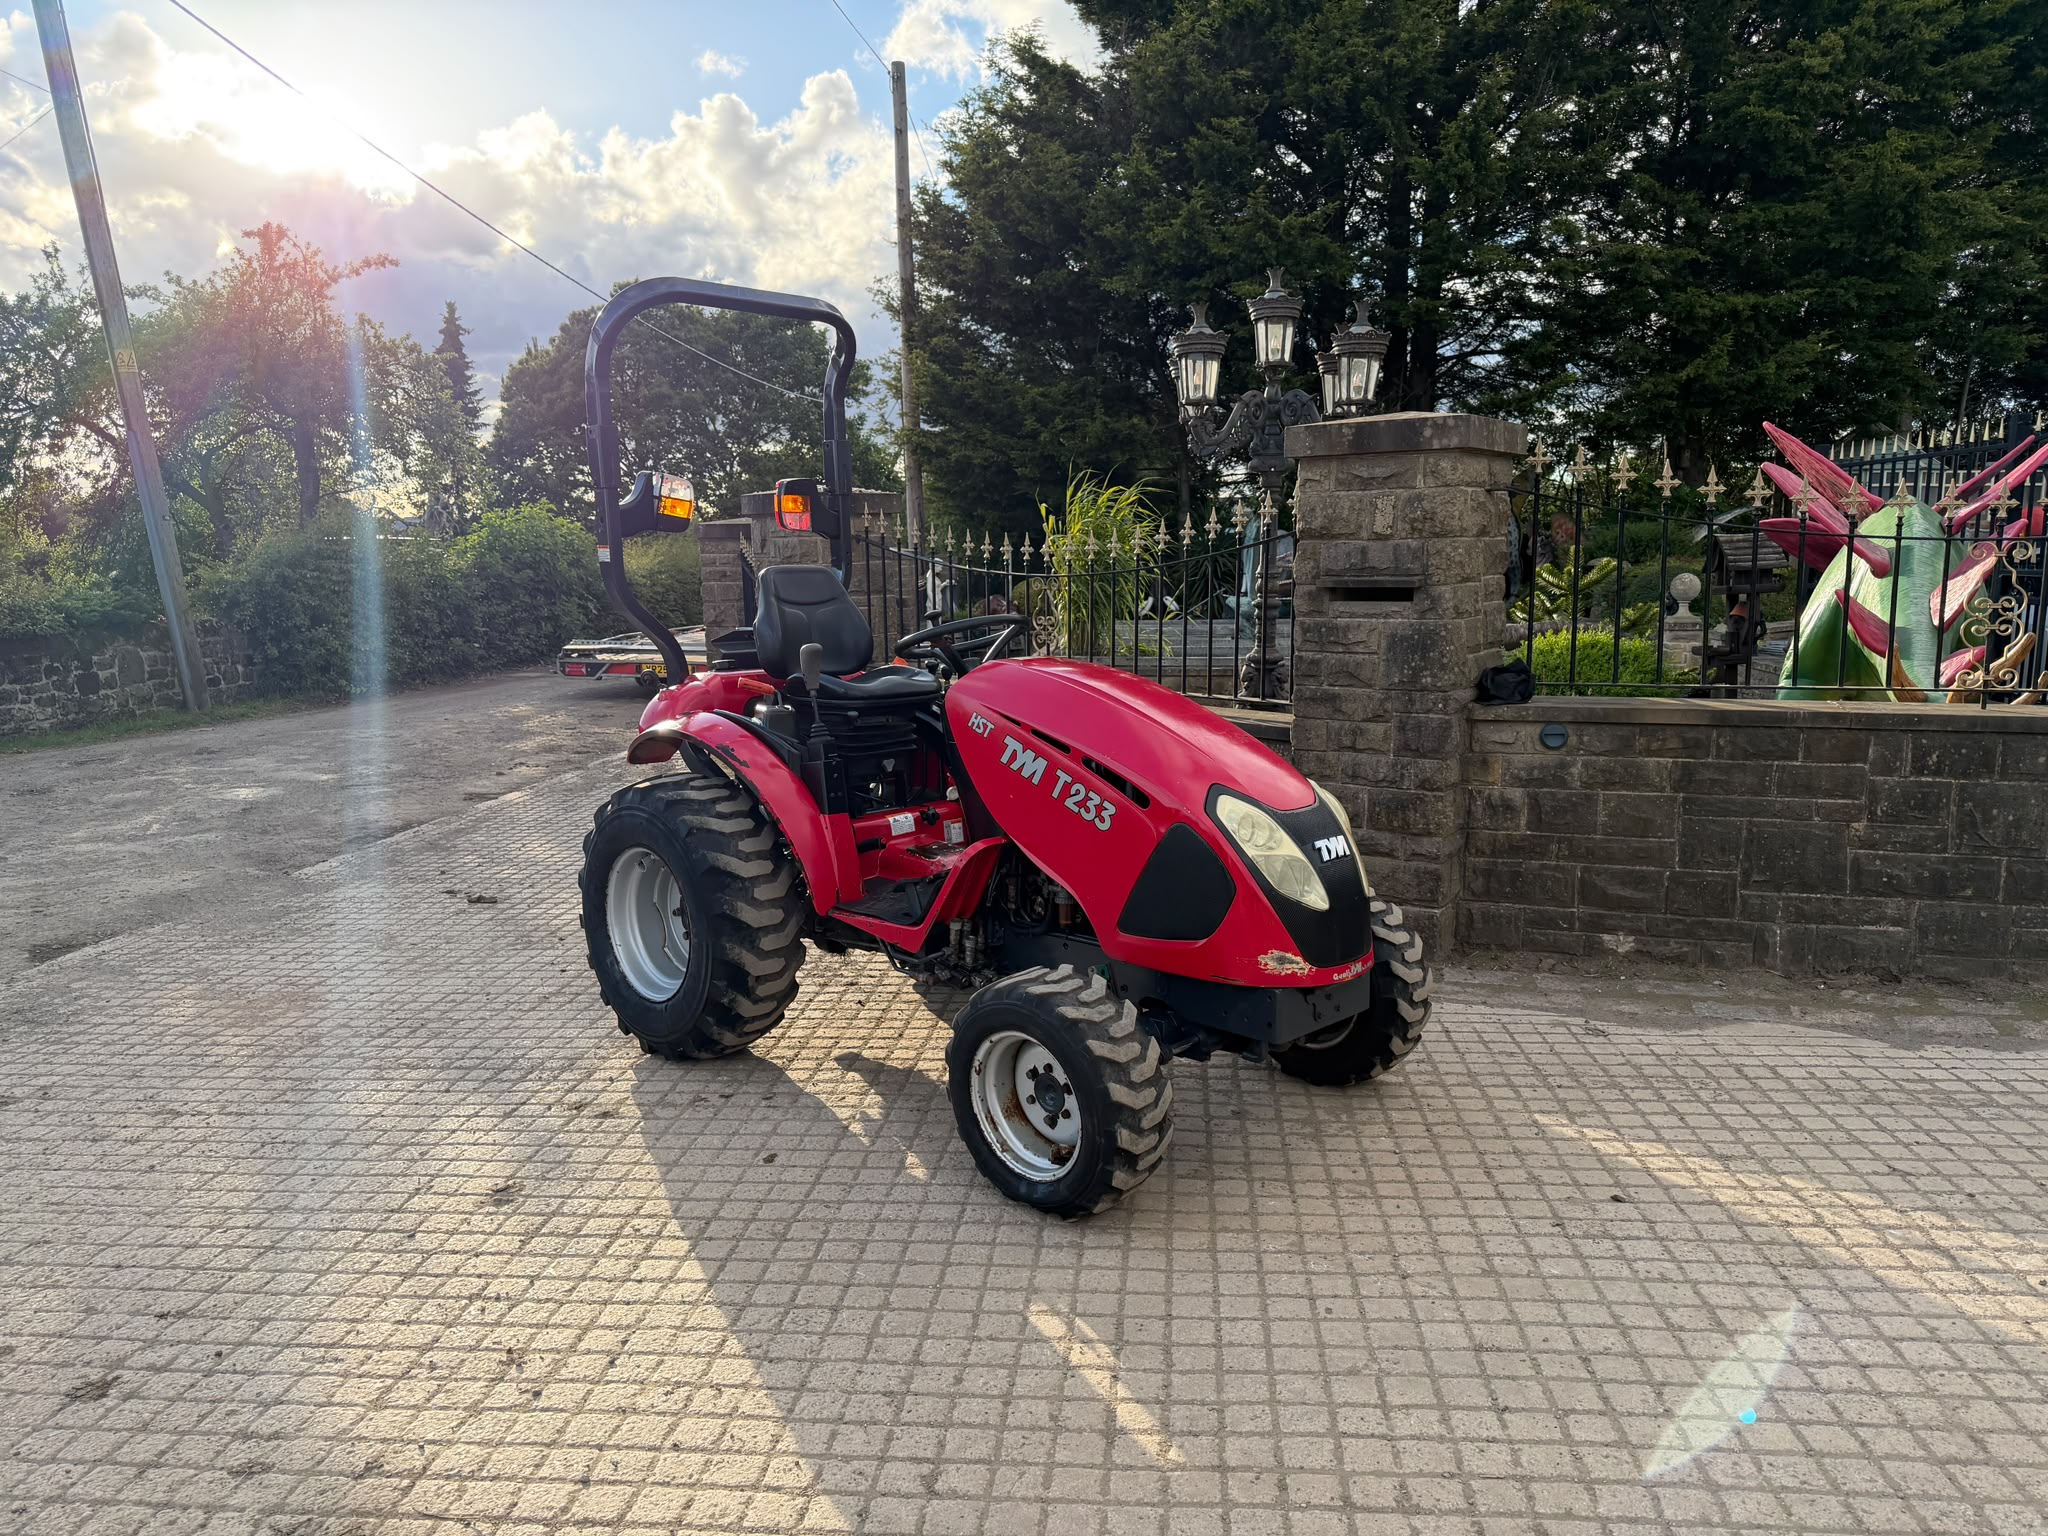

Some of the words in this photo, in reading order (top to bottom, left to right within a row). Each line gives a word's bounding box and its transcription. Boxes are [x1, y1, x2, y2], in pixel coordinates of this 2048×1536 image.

[967, 712, 995, 738] HST
[999, 735, 1049, 786] TYM
[1051, 769, 1072, 799] T
[1063, 783, 1117, 831] 233
[1313, 835, 1350, 862] TYM
